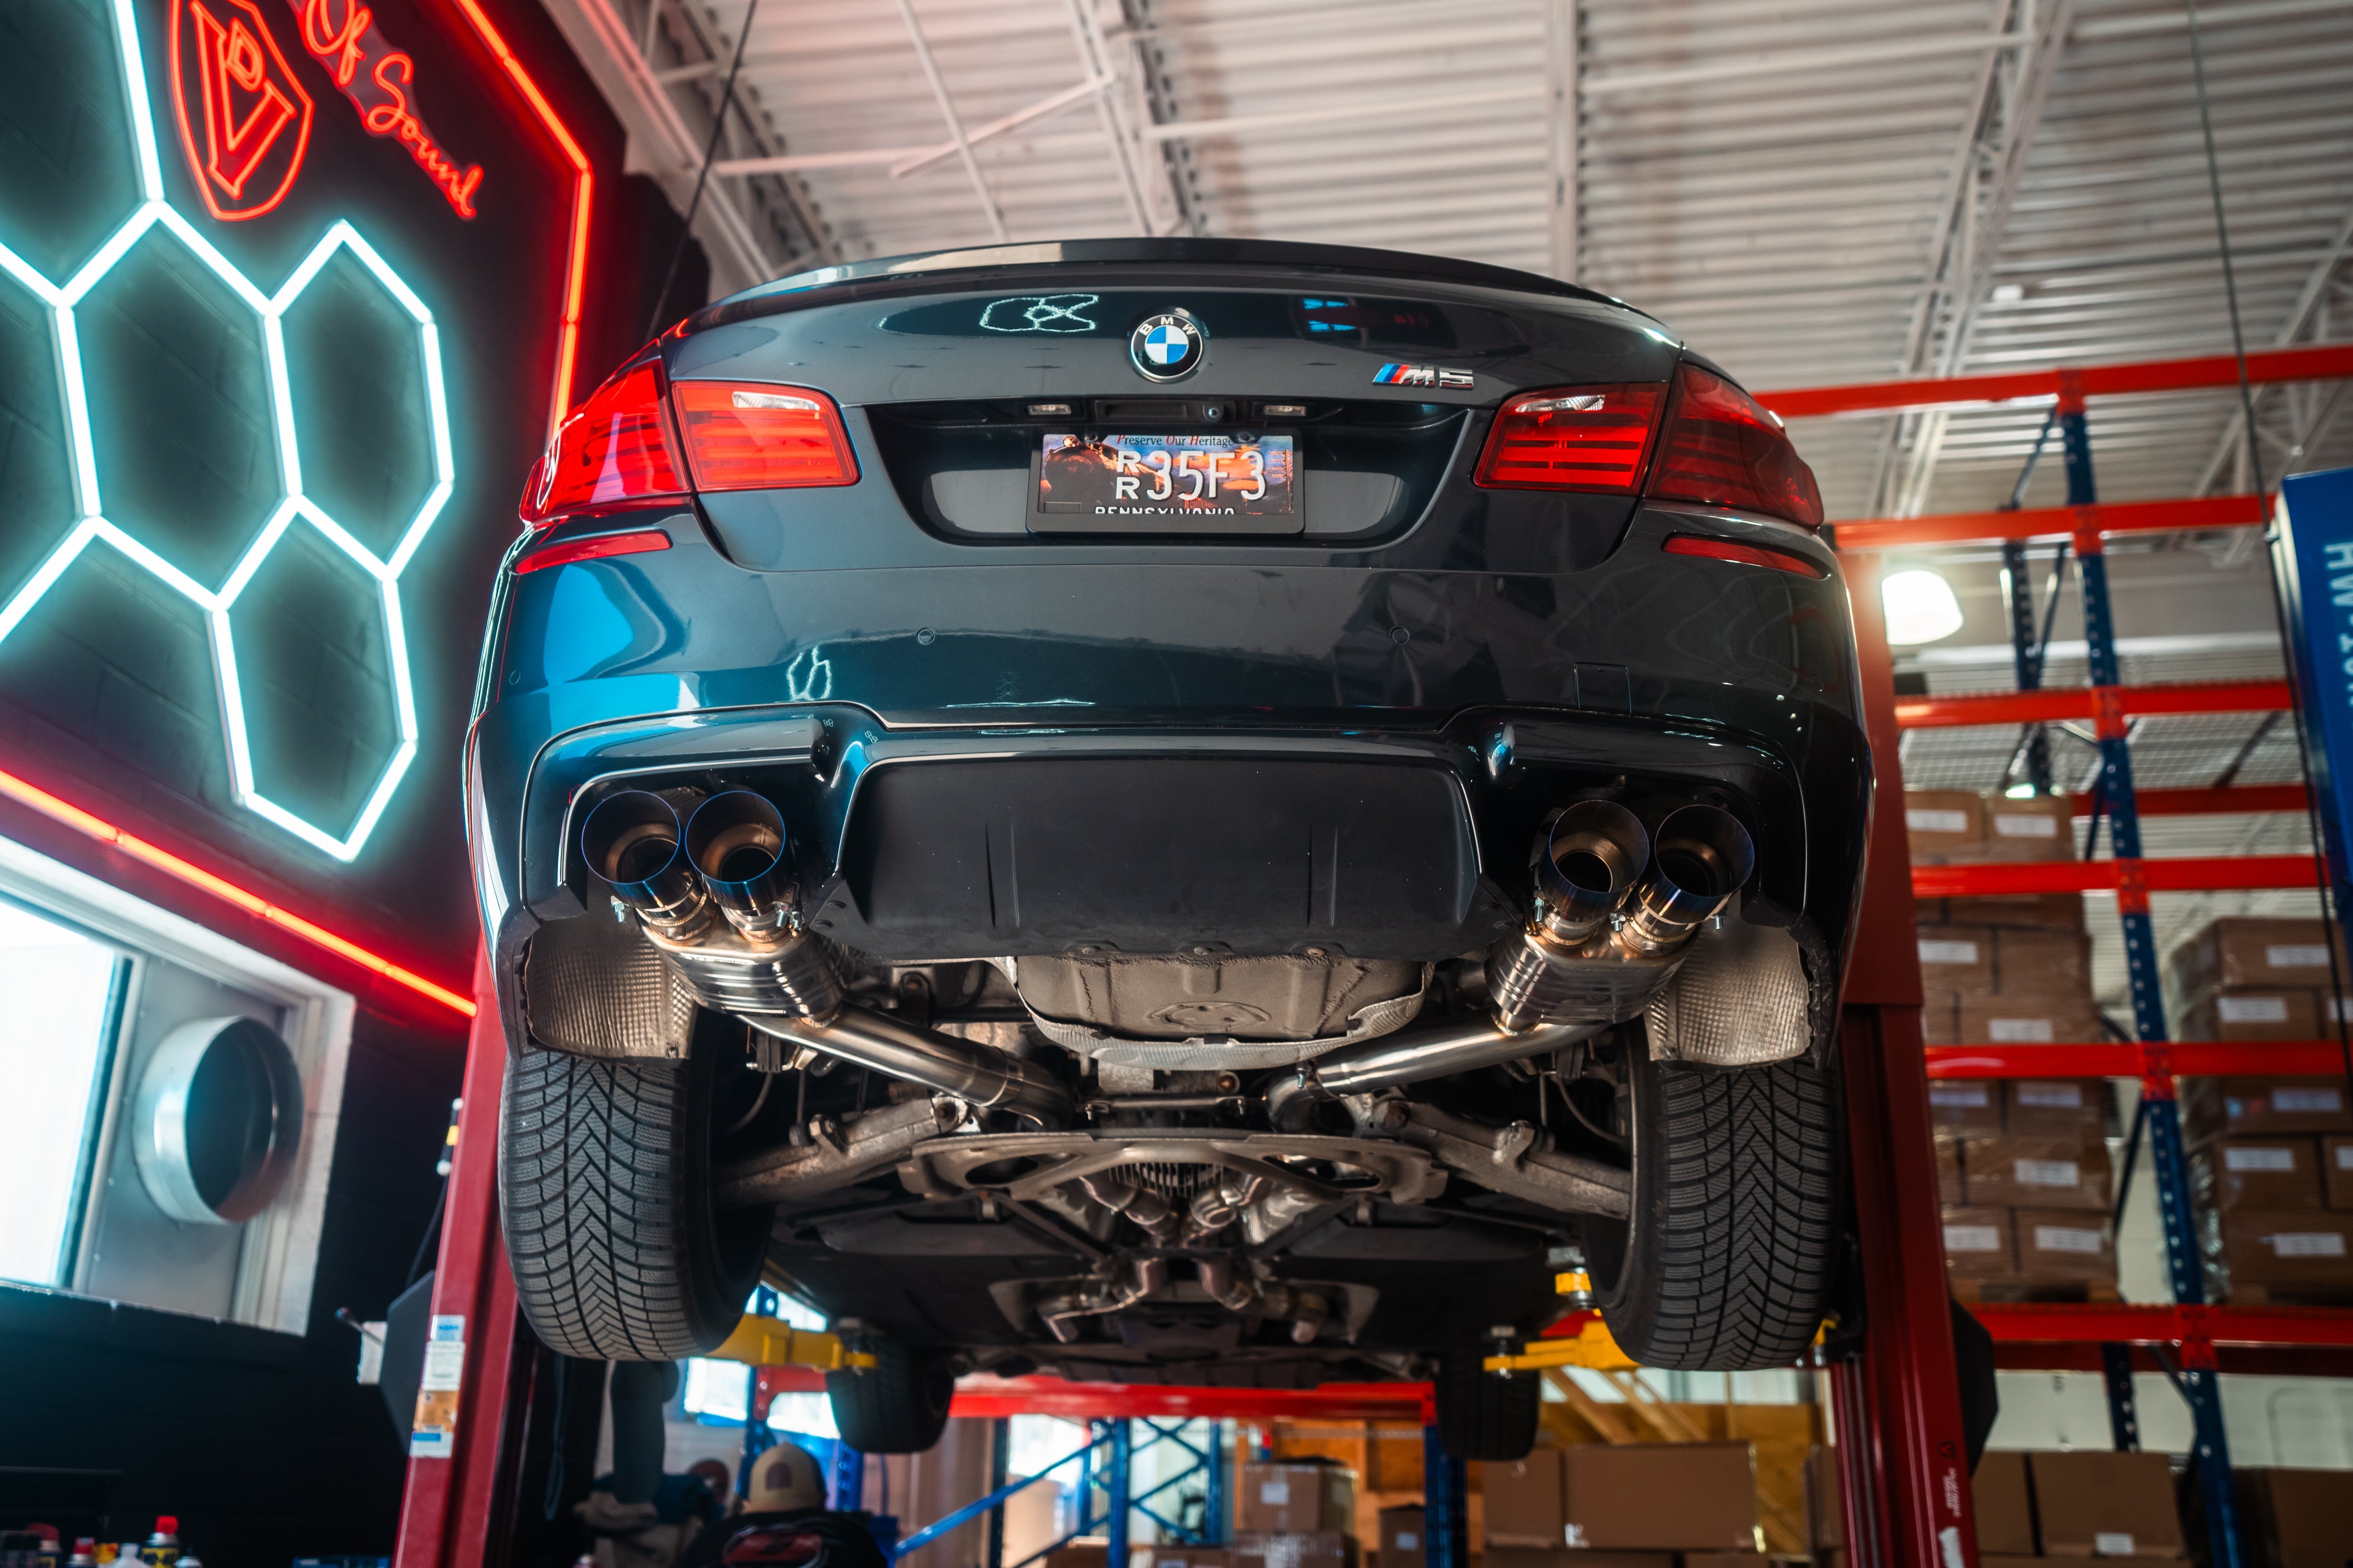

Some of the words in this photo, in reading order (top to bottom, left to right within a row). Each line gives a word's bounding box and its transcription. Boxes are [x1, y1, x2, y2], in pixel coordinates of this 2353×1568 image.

[370, 52, 484, 219] Sound
[1139, 316, 1196, 336] BMW
[1399, 364, 1474, 389] M5
[1117, 435, 1162, 445] Preserve
[1167, 436, 1186, 444] Our
[1189, 436, 1233, 447] Heritage
